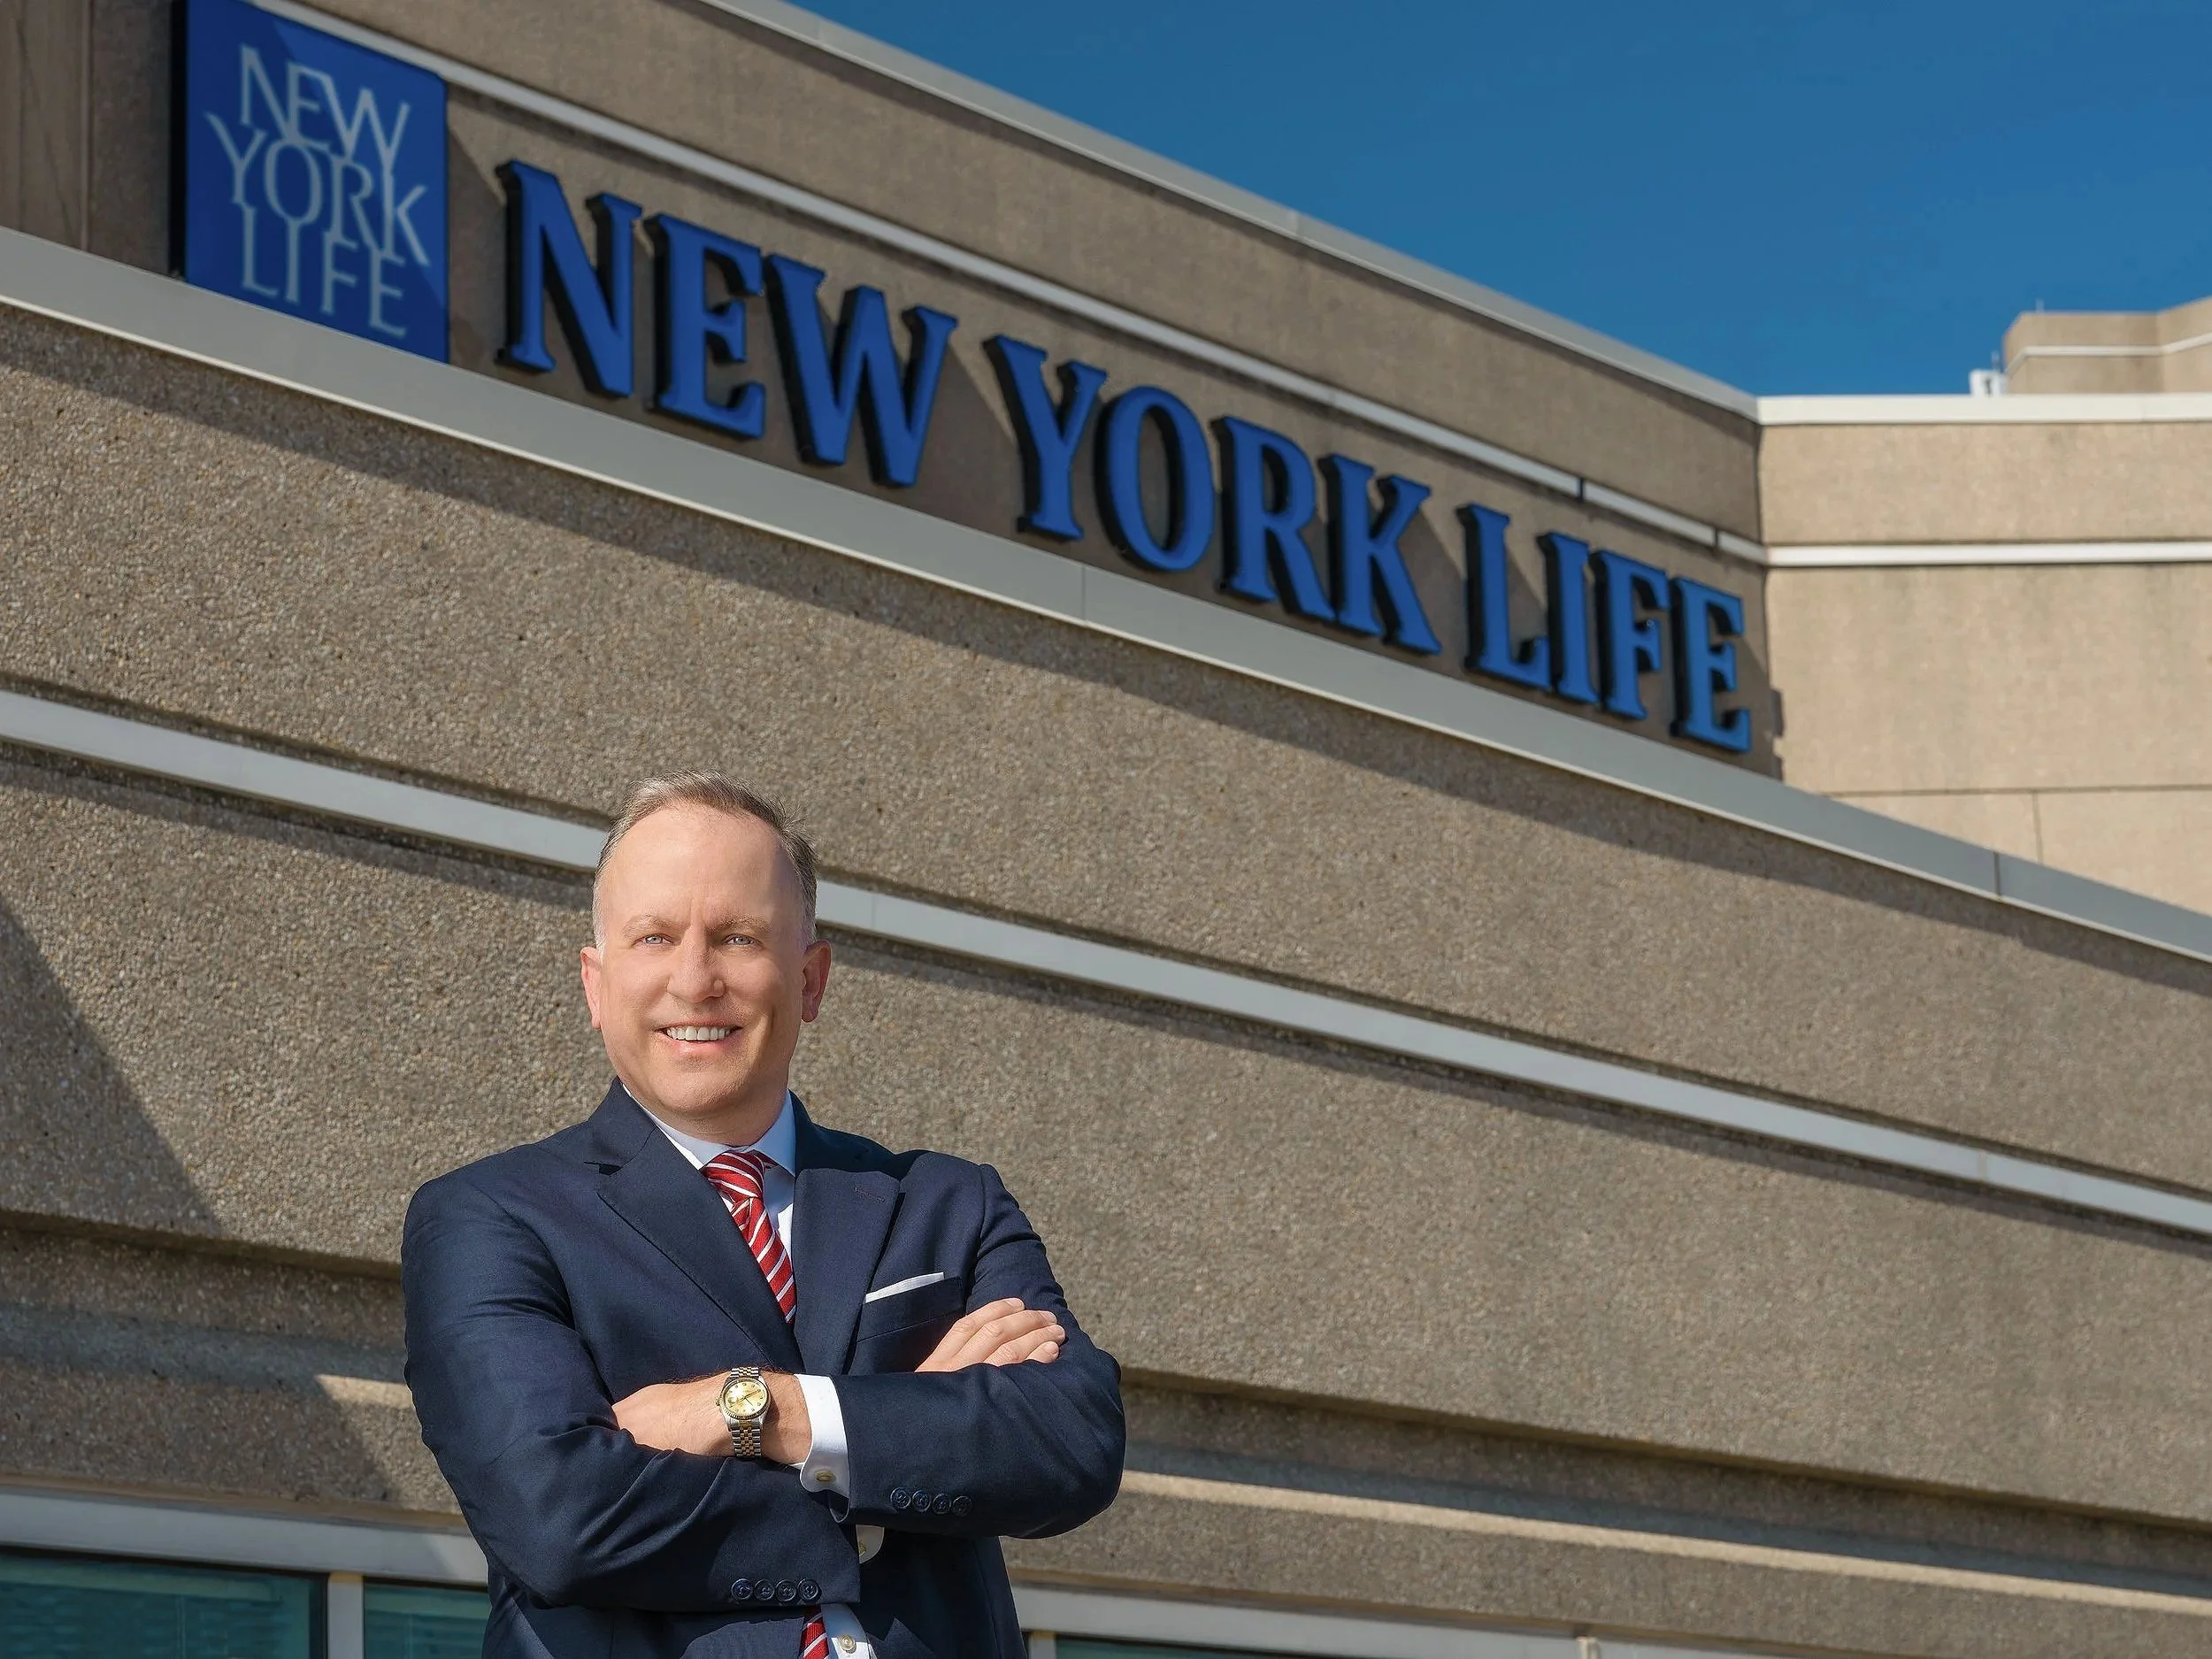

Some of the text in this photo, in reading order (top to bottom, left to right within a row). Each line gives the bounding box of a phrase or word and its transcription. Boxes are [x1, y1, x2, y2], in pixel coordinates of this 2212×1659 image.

[239, 42, 411, 166] NEW
[204, 111, 430, 265] YORK
[241, 205, 406, 337] LIFE
[496, 159, 1752, 753] NEW YORK LIFE
